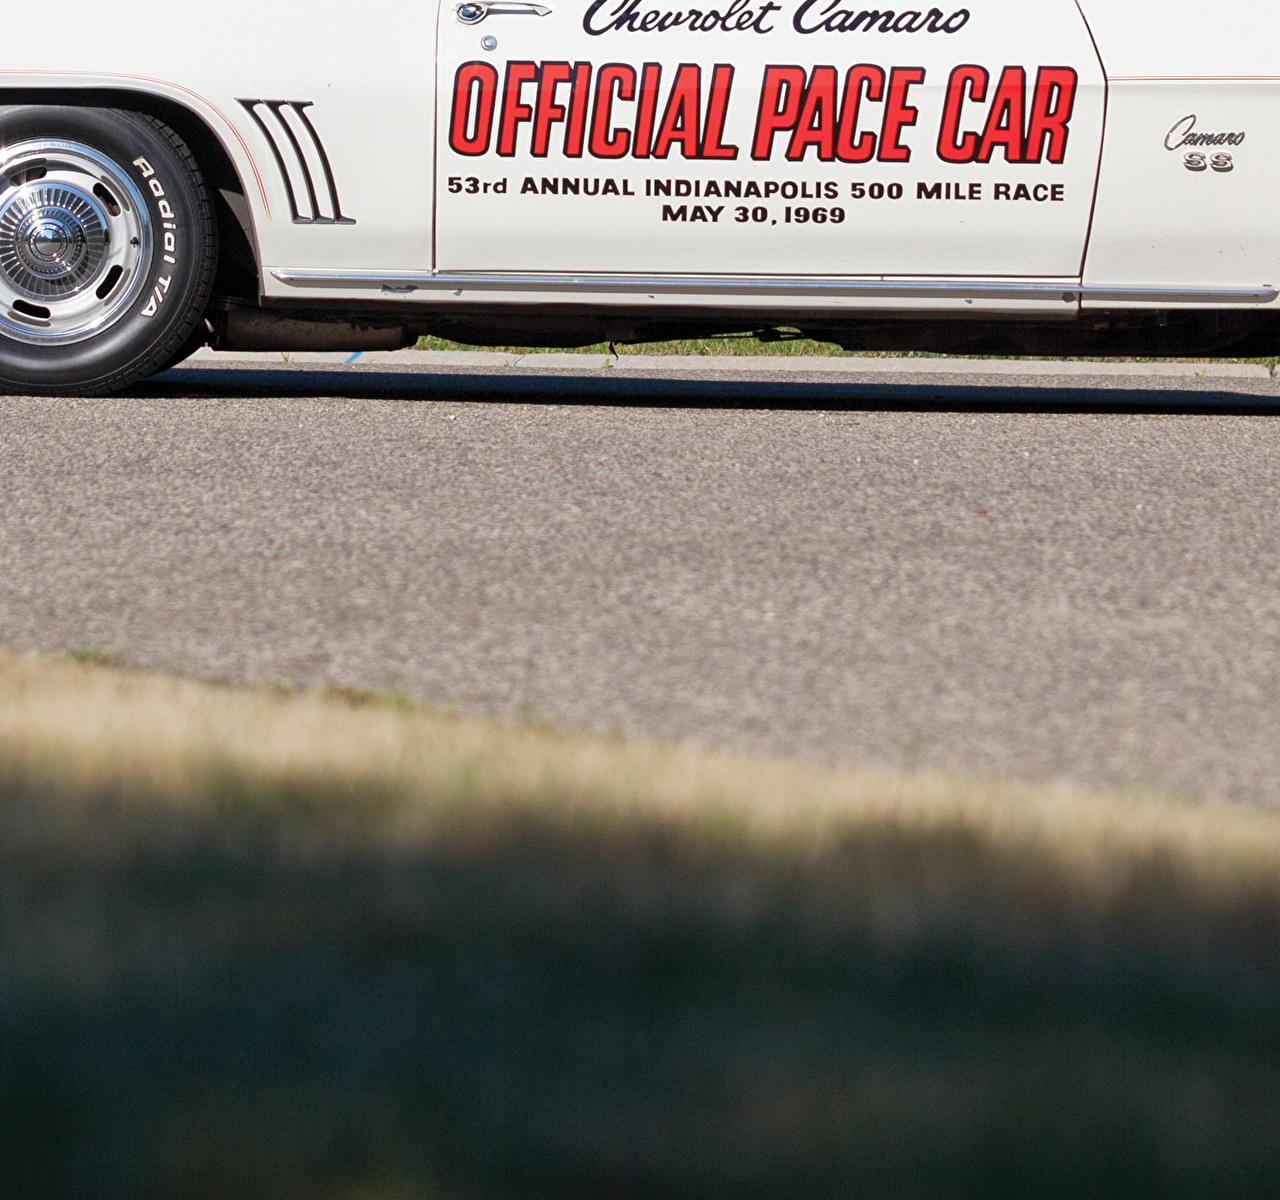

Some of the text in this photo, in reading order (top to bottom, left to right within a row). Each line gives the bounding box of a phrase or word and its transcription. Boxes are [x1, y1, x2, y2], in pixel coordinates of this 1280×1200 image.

[447, 59, 1079, 165] OFFICIAL PACE CAR
[1164, 114, 1245, 151] Camaro
[1183, 151, 1234, 173] SS
[448, 176, 1065, 202] 53rd ANNUAL INDIANAPOLIS 500 MILE RACE
[661, 204, 725, 223] MAY
[133, 155, 176, 318] Radial T/A
